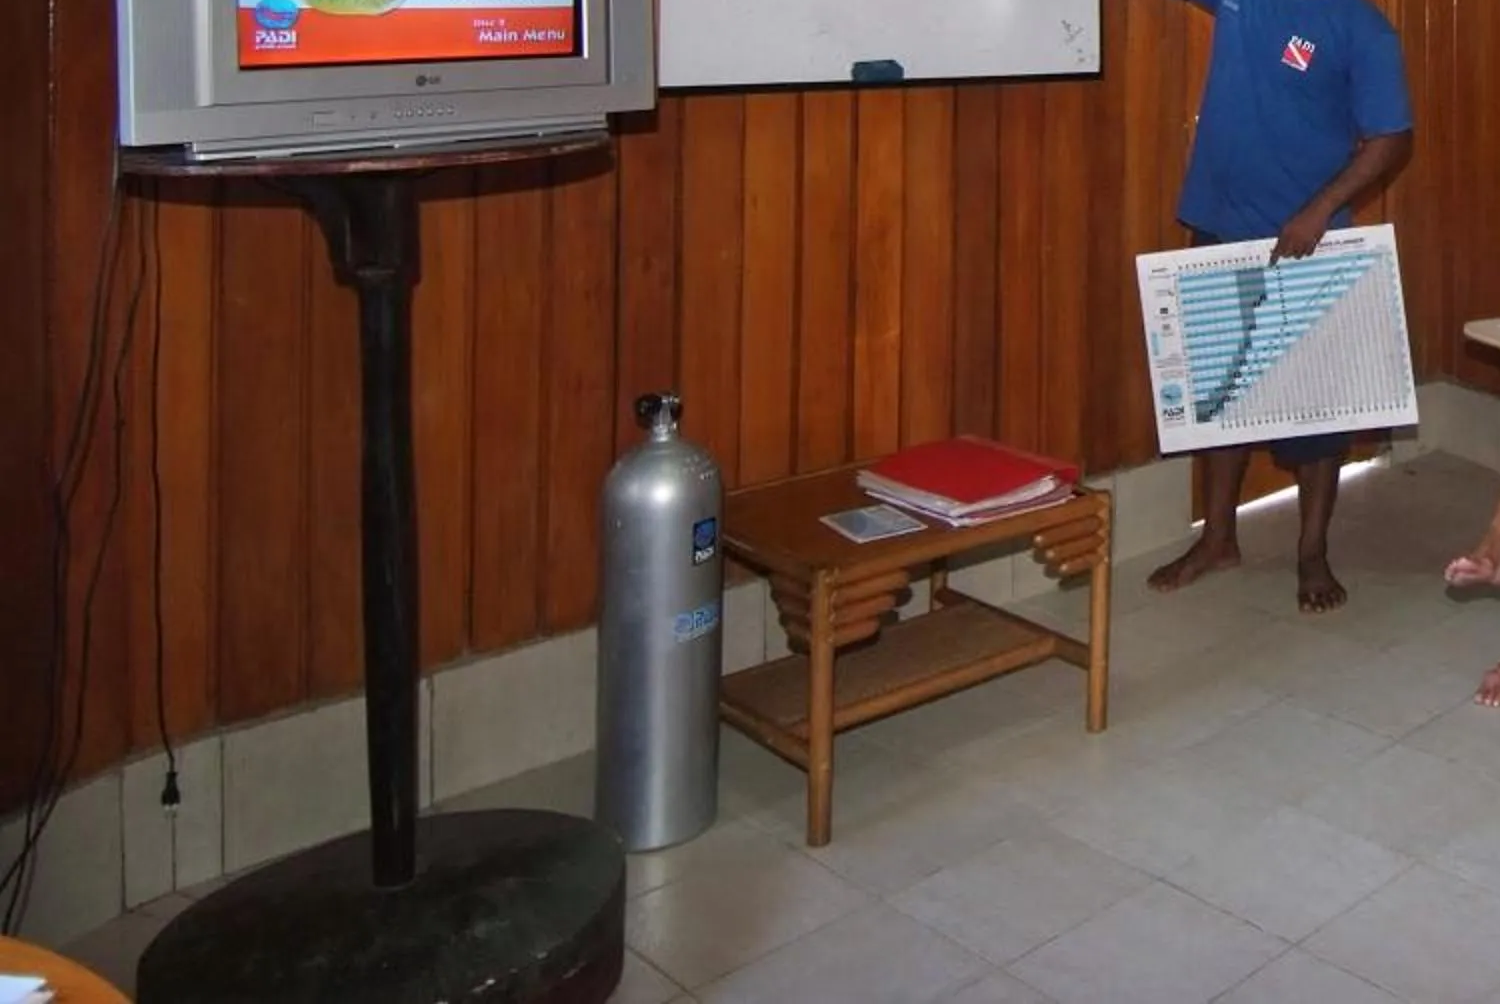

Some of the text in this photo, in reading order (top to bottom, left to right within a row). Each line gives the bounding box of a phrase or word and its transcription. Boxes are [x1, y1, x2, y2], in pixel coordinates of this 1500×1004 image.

[255, 30, 296, 44] PADI
[479, 29, 565, 42] Main Menu
